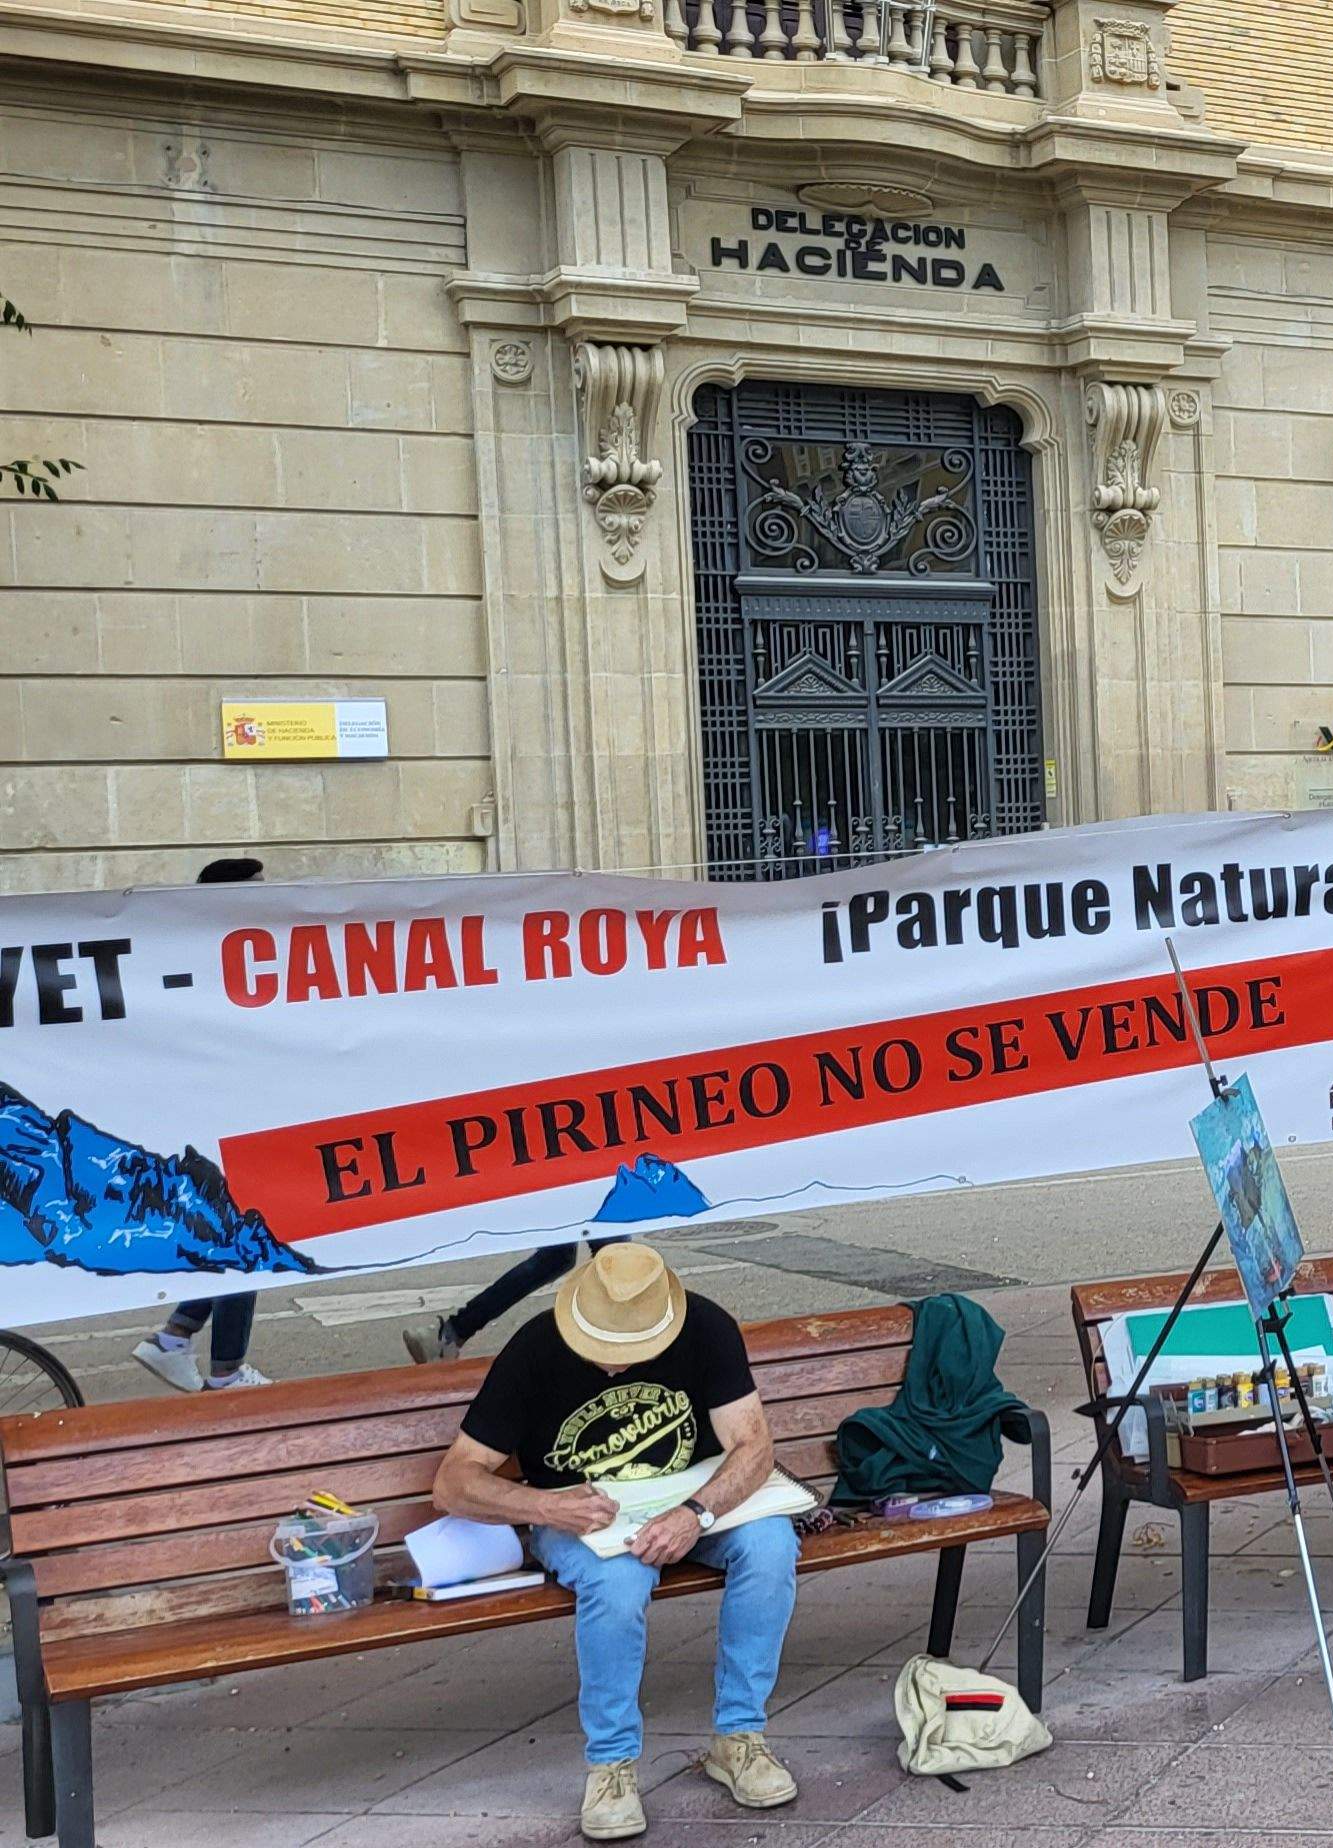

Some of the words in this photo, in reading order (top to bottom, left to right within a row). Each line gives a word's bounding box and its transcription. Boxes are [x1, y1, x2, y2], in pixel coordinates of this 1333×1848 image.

[711, 236, 1006, 292] HACIENDA
[751, 207, 966, 250] DELEGACION
[220, 914, 499, 1008] CANAL
[522, 906, 727, 981] ROYA
[820, 876, 1111, 964] ¡Parque
[315, 1130, 427, 1205] EL
[446, 1061, 792, 1177] PIRINEO
[817, 1038, 923, 1107] NO
[946, 1019, 1030, 1083] SE
[1047, 975, 1286, 1062] VENDE
